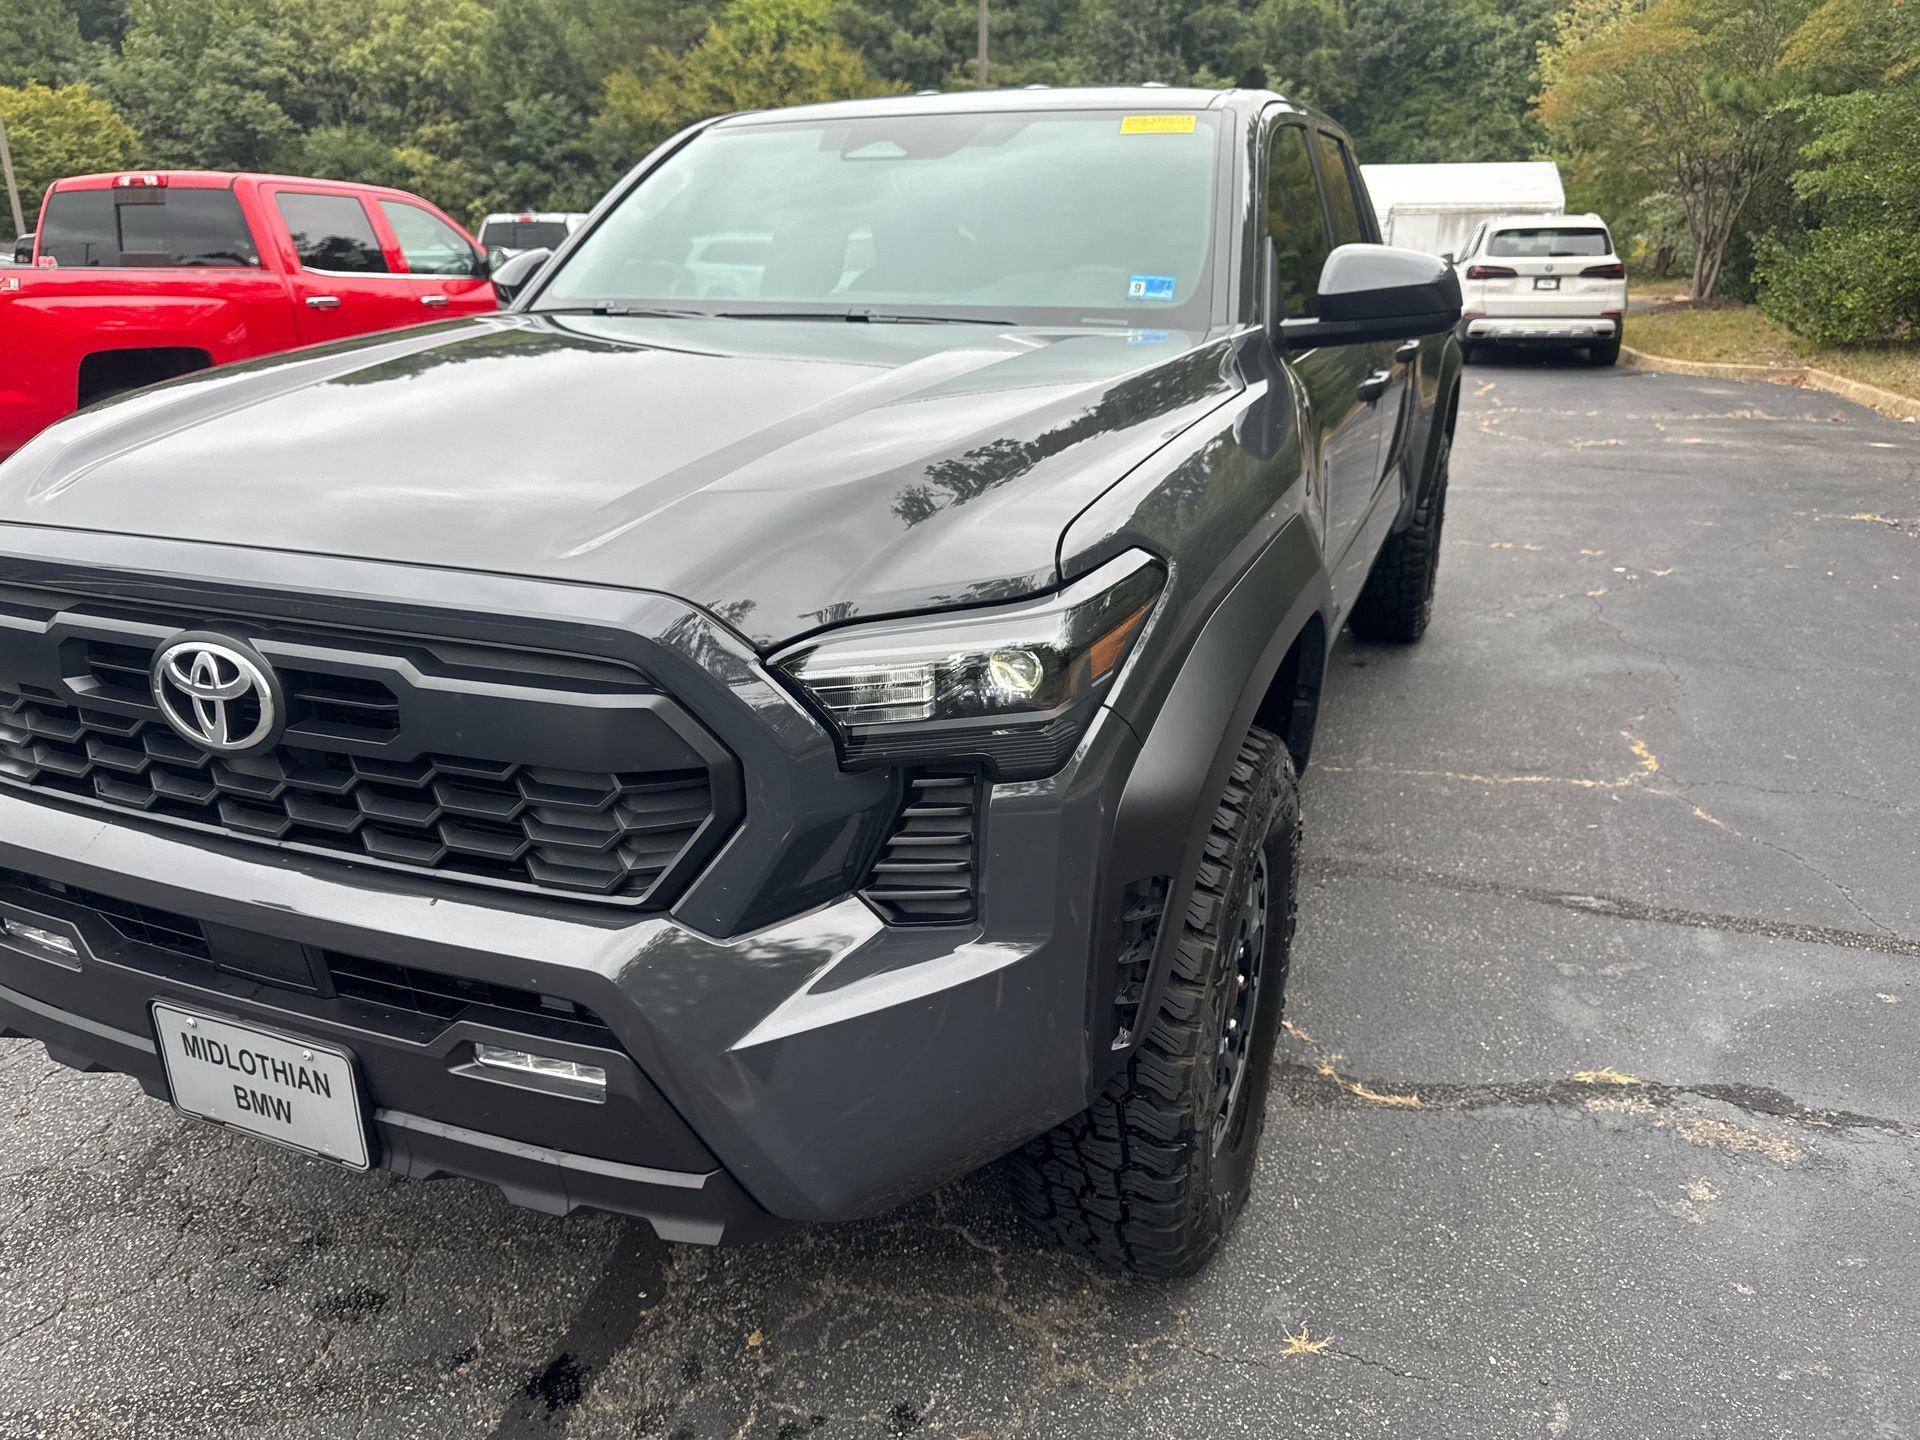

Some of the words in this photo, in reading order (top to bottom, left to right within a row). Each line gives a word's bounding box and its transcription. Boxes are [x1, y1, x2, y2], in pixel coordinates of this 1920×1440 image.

[1134, 283, 1142, 293] 9
[181, 1032, 331, 1099] MIDLOTHIAN
[233, 1084, 292, 1124] BMW
